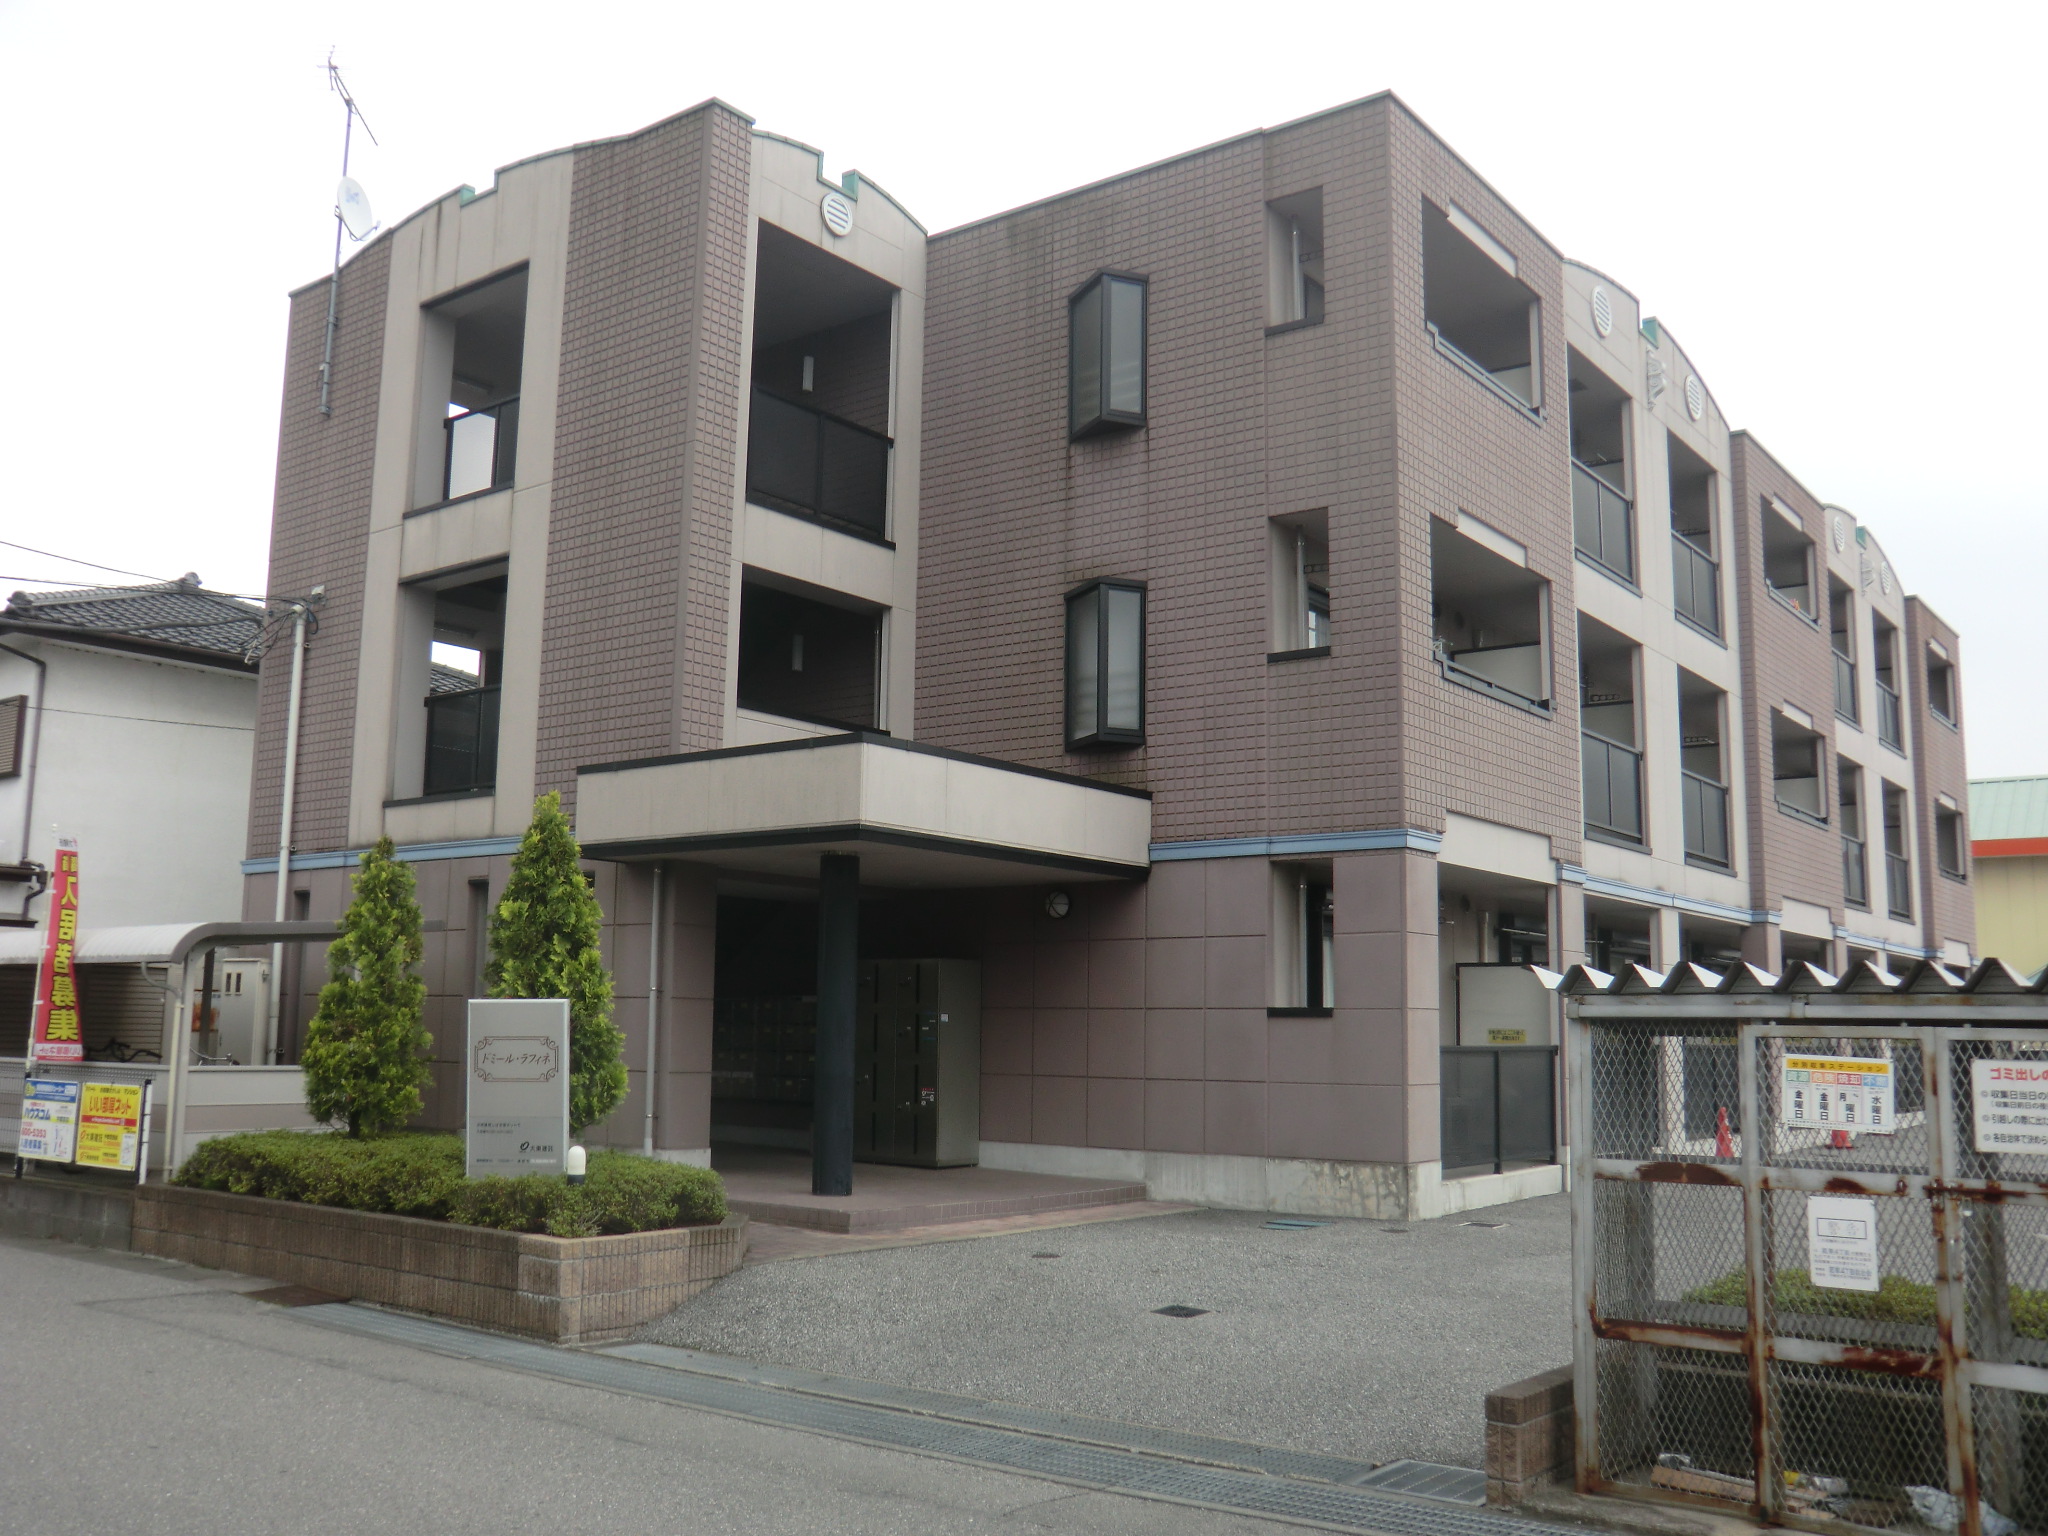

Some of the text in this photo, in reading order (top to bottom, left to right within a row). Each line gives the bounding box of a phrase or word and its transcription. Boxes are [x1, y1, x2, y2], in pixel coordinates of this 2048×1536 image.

[482, 1053, 551, 1065] ドミール・ラフィネ
[1792, 1061, 1884, 1072] 分別収集ステーション
[89, 1096, 132, 1115] いい部屋ネット
[1795, 1090, 1804, 1118] 金曜日
[1820, 1092, 1829, 1120] 金曜日
[1872, 1095, 1882, 1124] 水曜日
